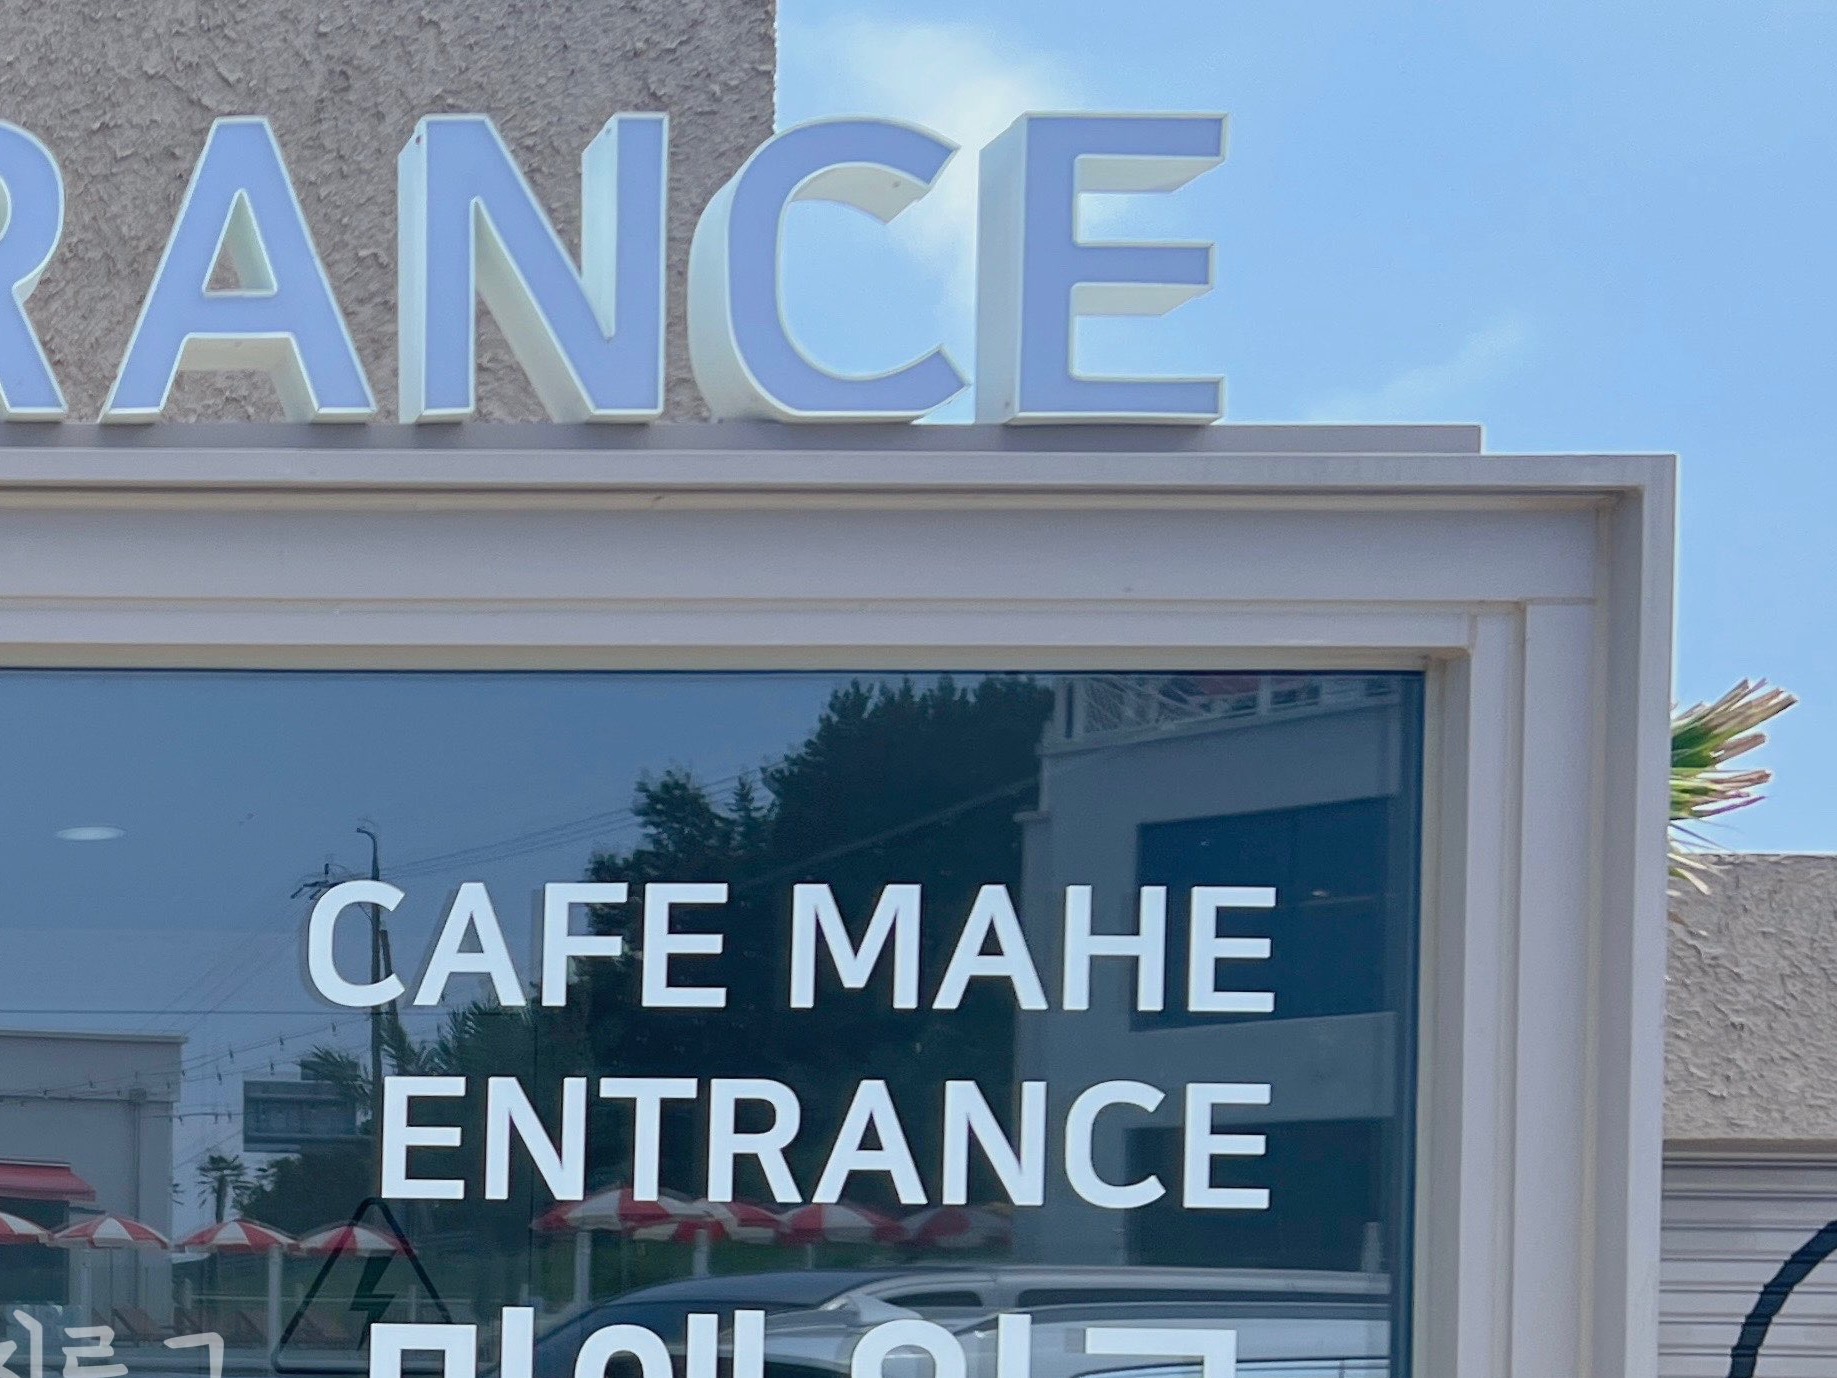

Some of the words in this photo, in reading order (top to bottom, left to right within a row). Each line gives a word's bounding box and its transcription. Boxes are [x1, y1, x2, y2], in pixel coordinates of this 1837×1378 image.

[307, 880, 730, 1008] CAFE
[789, 883, 1277, 1014] MAHE
[380, 1075, 1272, 1210] ENTRANCE
